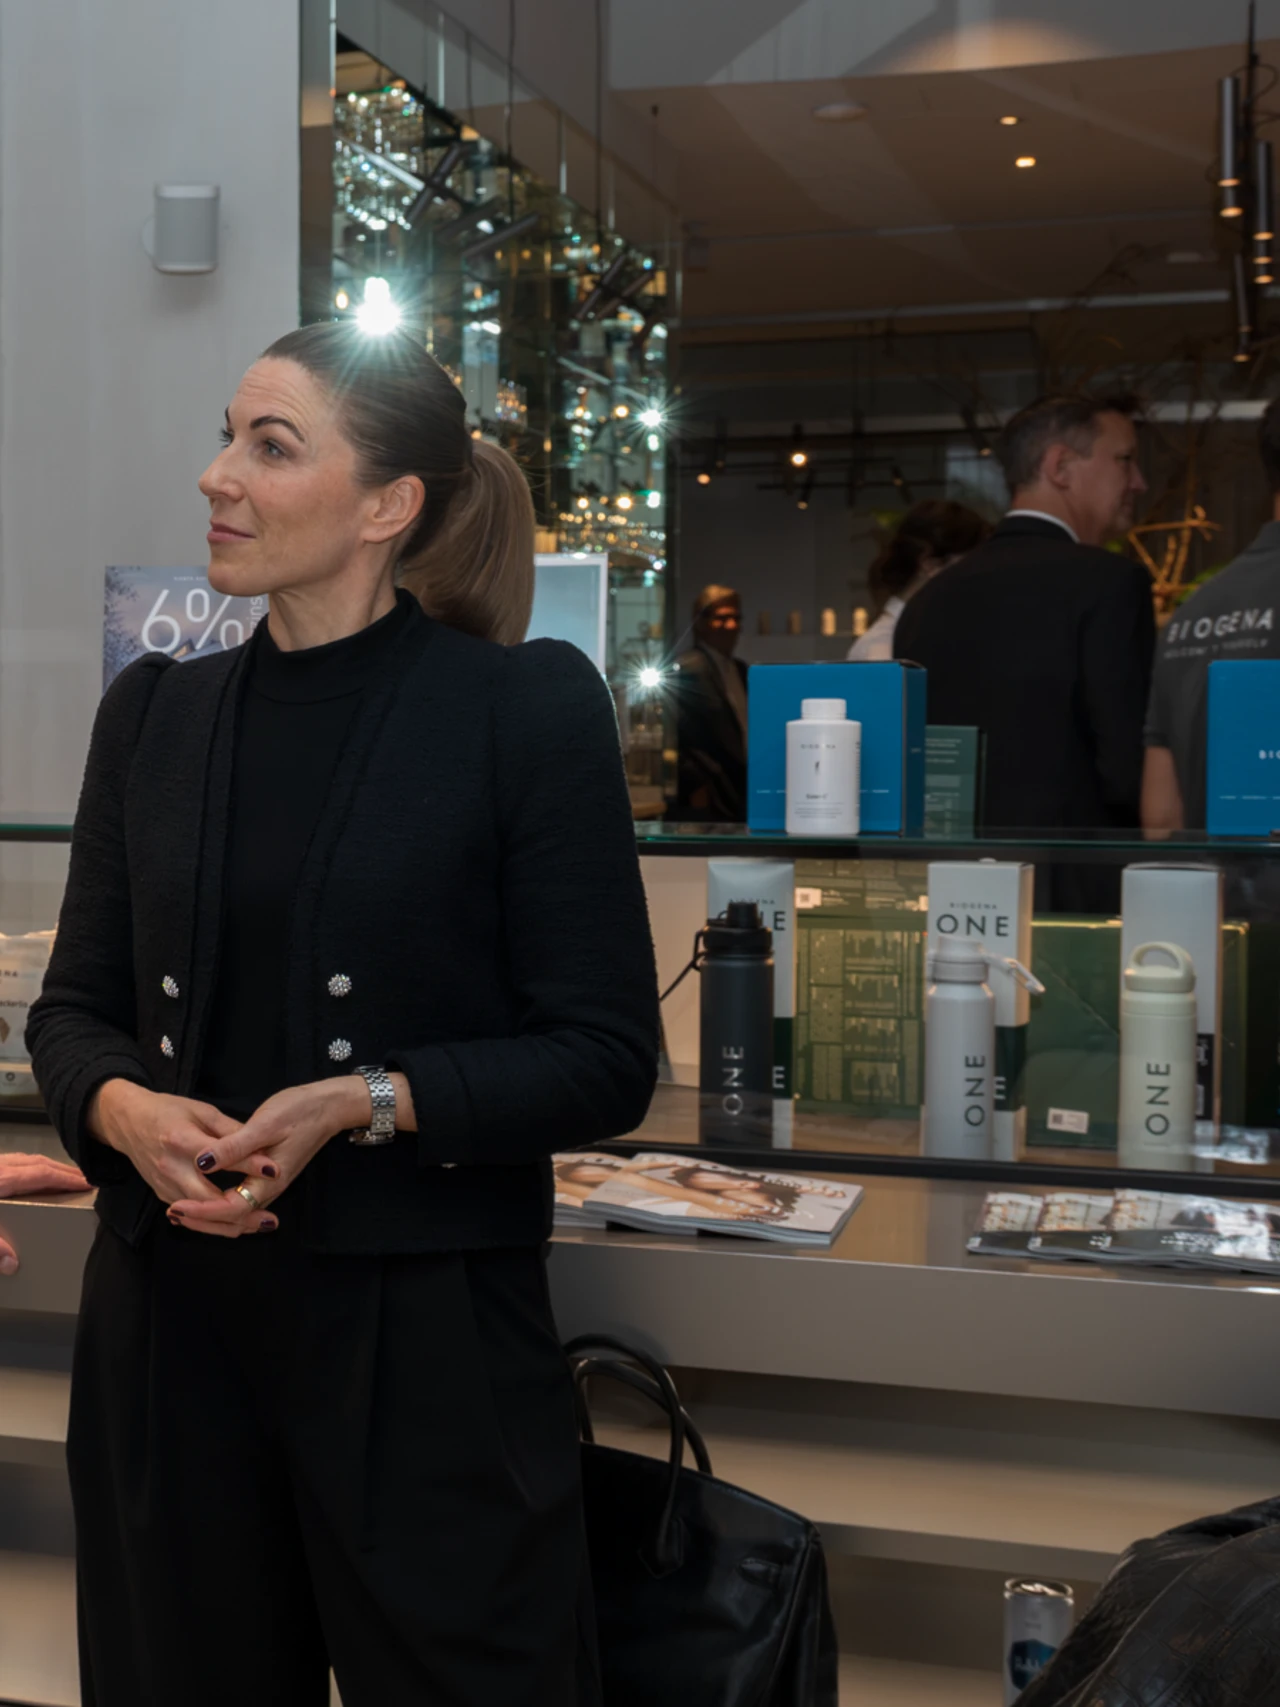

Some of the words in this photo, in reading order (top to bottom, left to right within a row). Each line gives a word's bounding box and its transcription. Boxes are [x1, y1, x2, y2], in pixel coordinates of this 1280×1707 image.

[141, 588, 244, 653] 6%
[937, 914, 1009, 937] ONE
[722, 1046, 744, 1116] ONE
[964, 1055, 985, 1127] ONE
[1145, 1062, 1171, 1136] ONE
